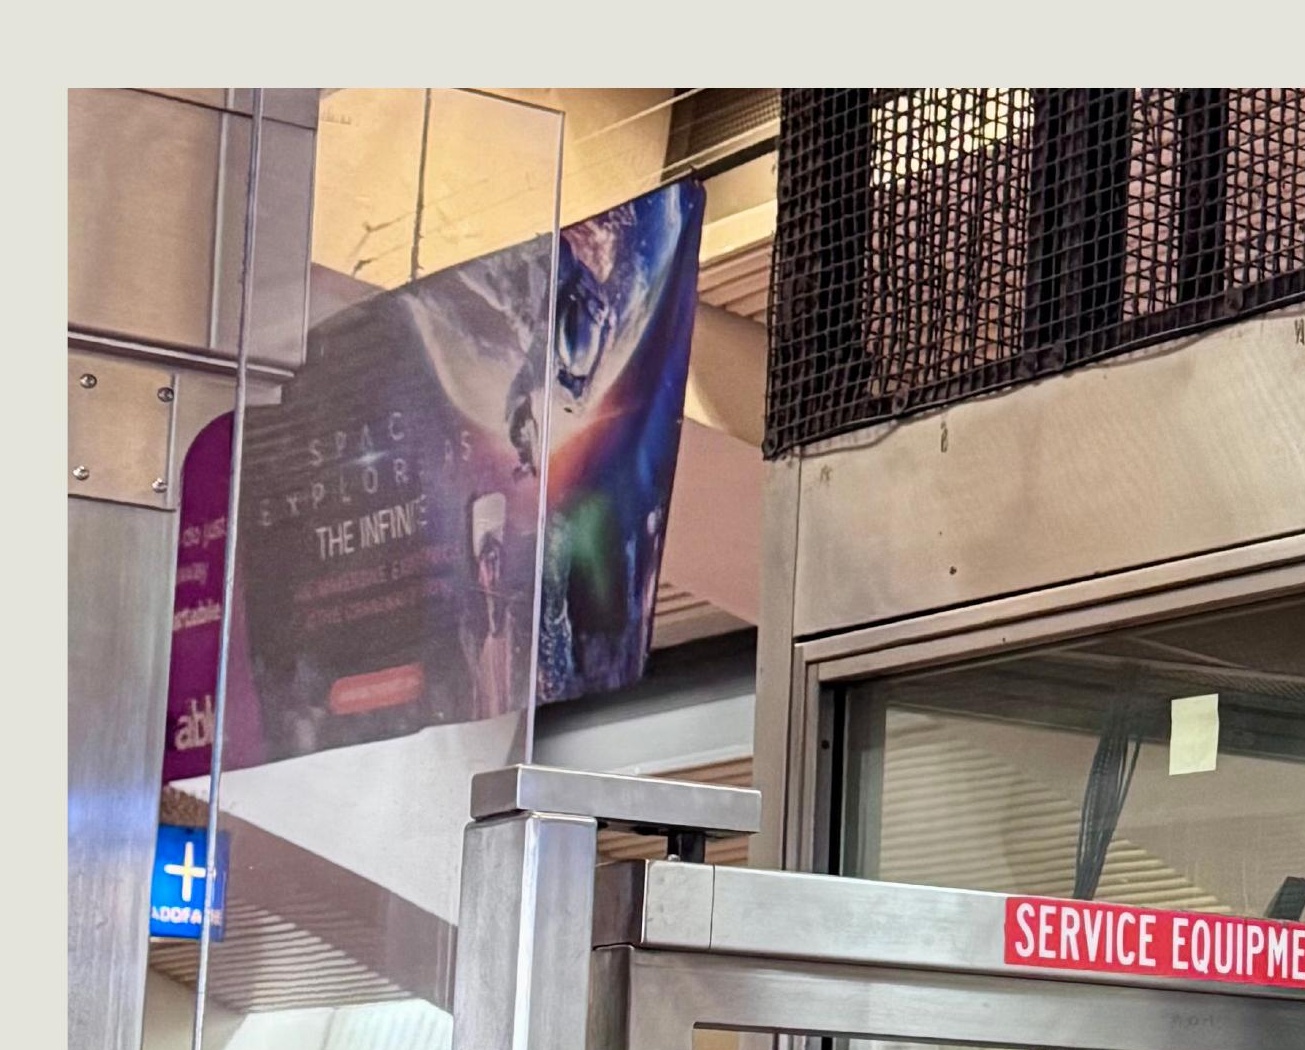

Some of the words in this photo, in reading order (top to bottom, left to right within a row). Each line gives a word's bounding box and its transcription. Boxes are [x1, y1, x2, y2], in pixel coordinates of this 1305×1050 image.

[315, 520, 356, 561] THE
[359, 494, 429, 549] INFINE
[1015, 901, 1157, 967] SERVICE
